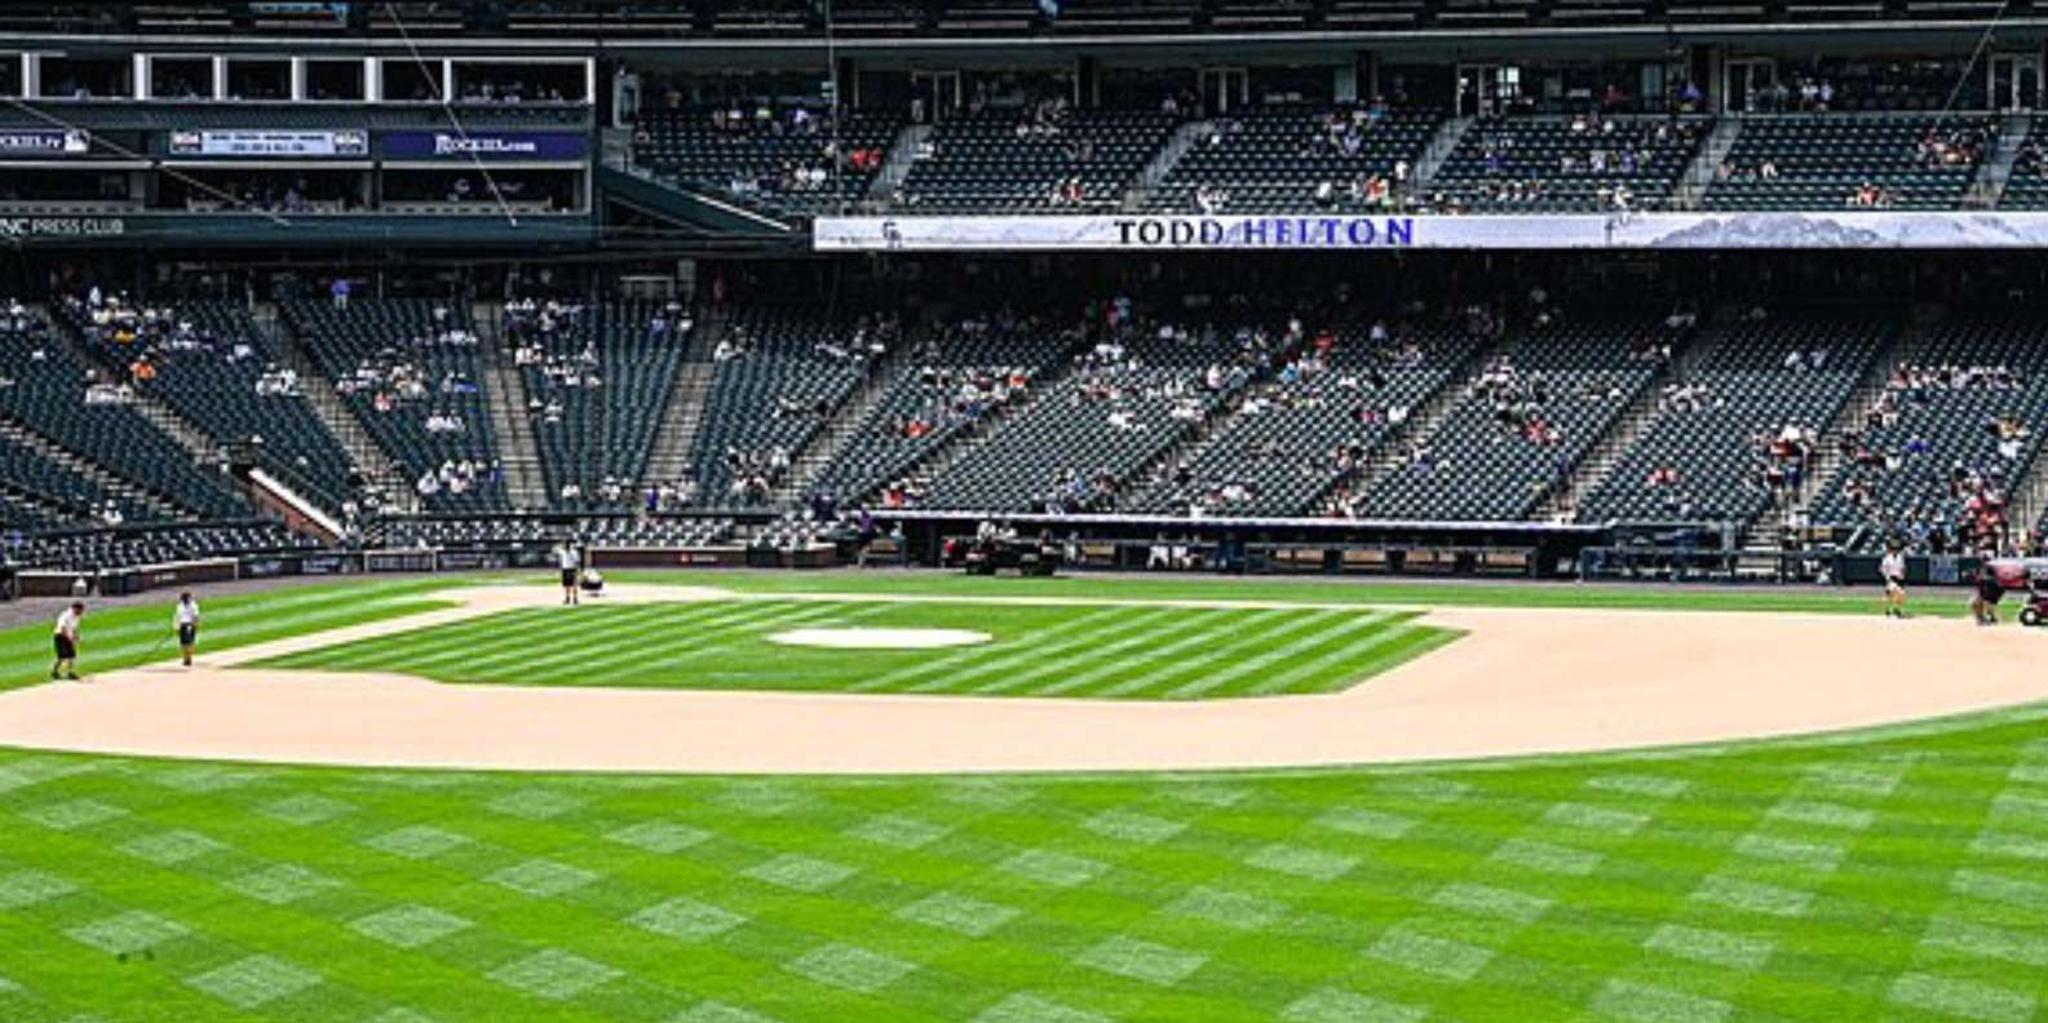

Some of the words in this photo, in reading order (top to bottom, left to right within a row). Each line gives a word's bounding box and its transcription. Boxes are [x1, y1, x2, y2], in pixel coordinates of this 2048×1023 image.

[32, 219, 80, 234] PRESS
[82, 219, 124, 234] CLUB
[1114, 219, 1223, 244] TODD
[1244, 218, 1414, 245] HELTON
